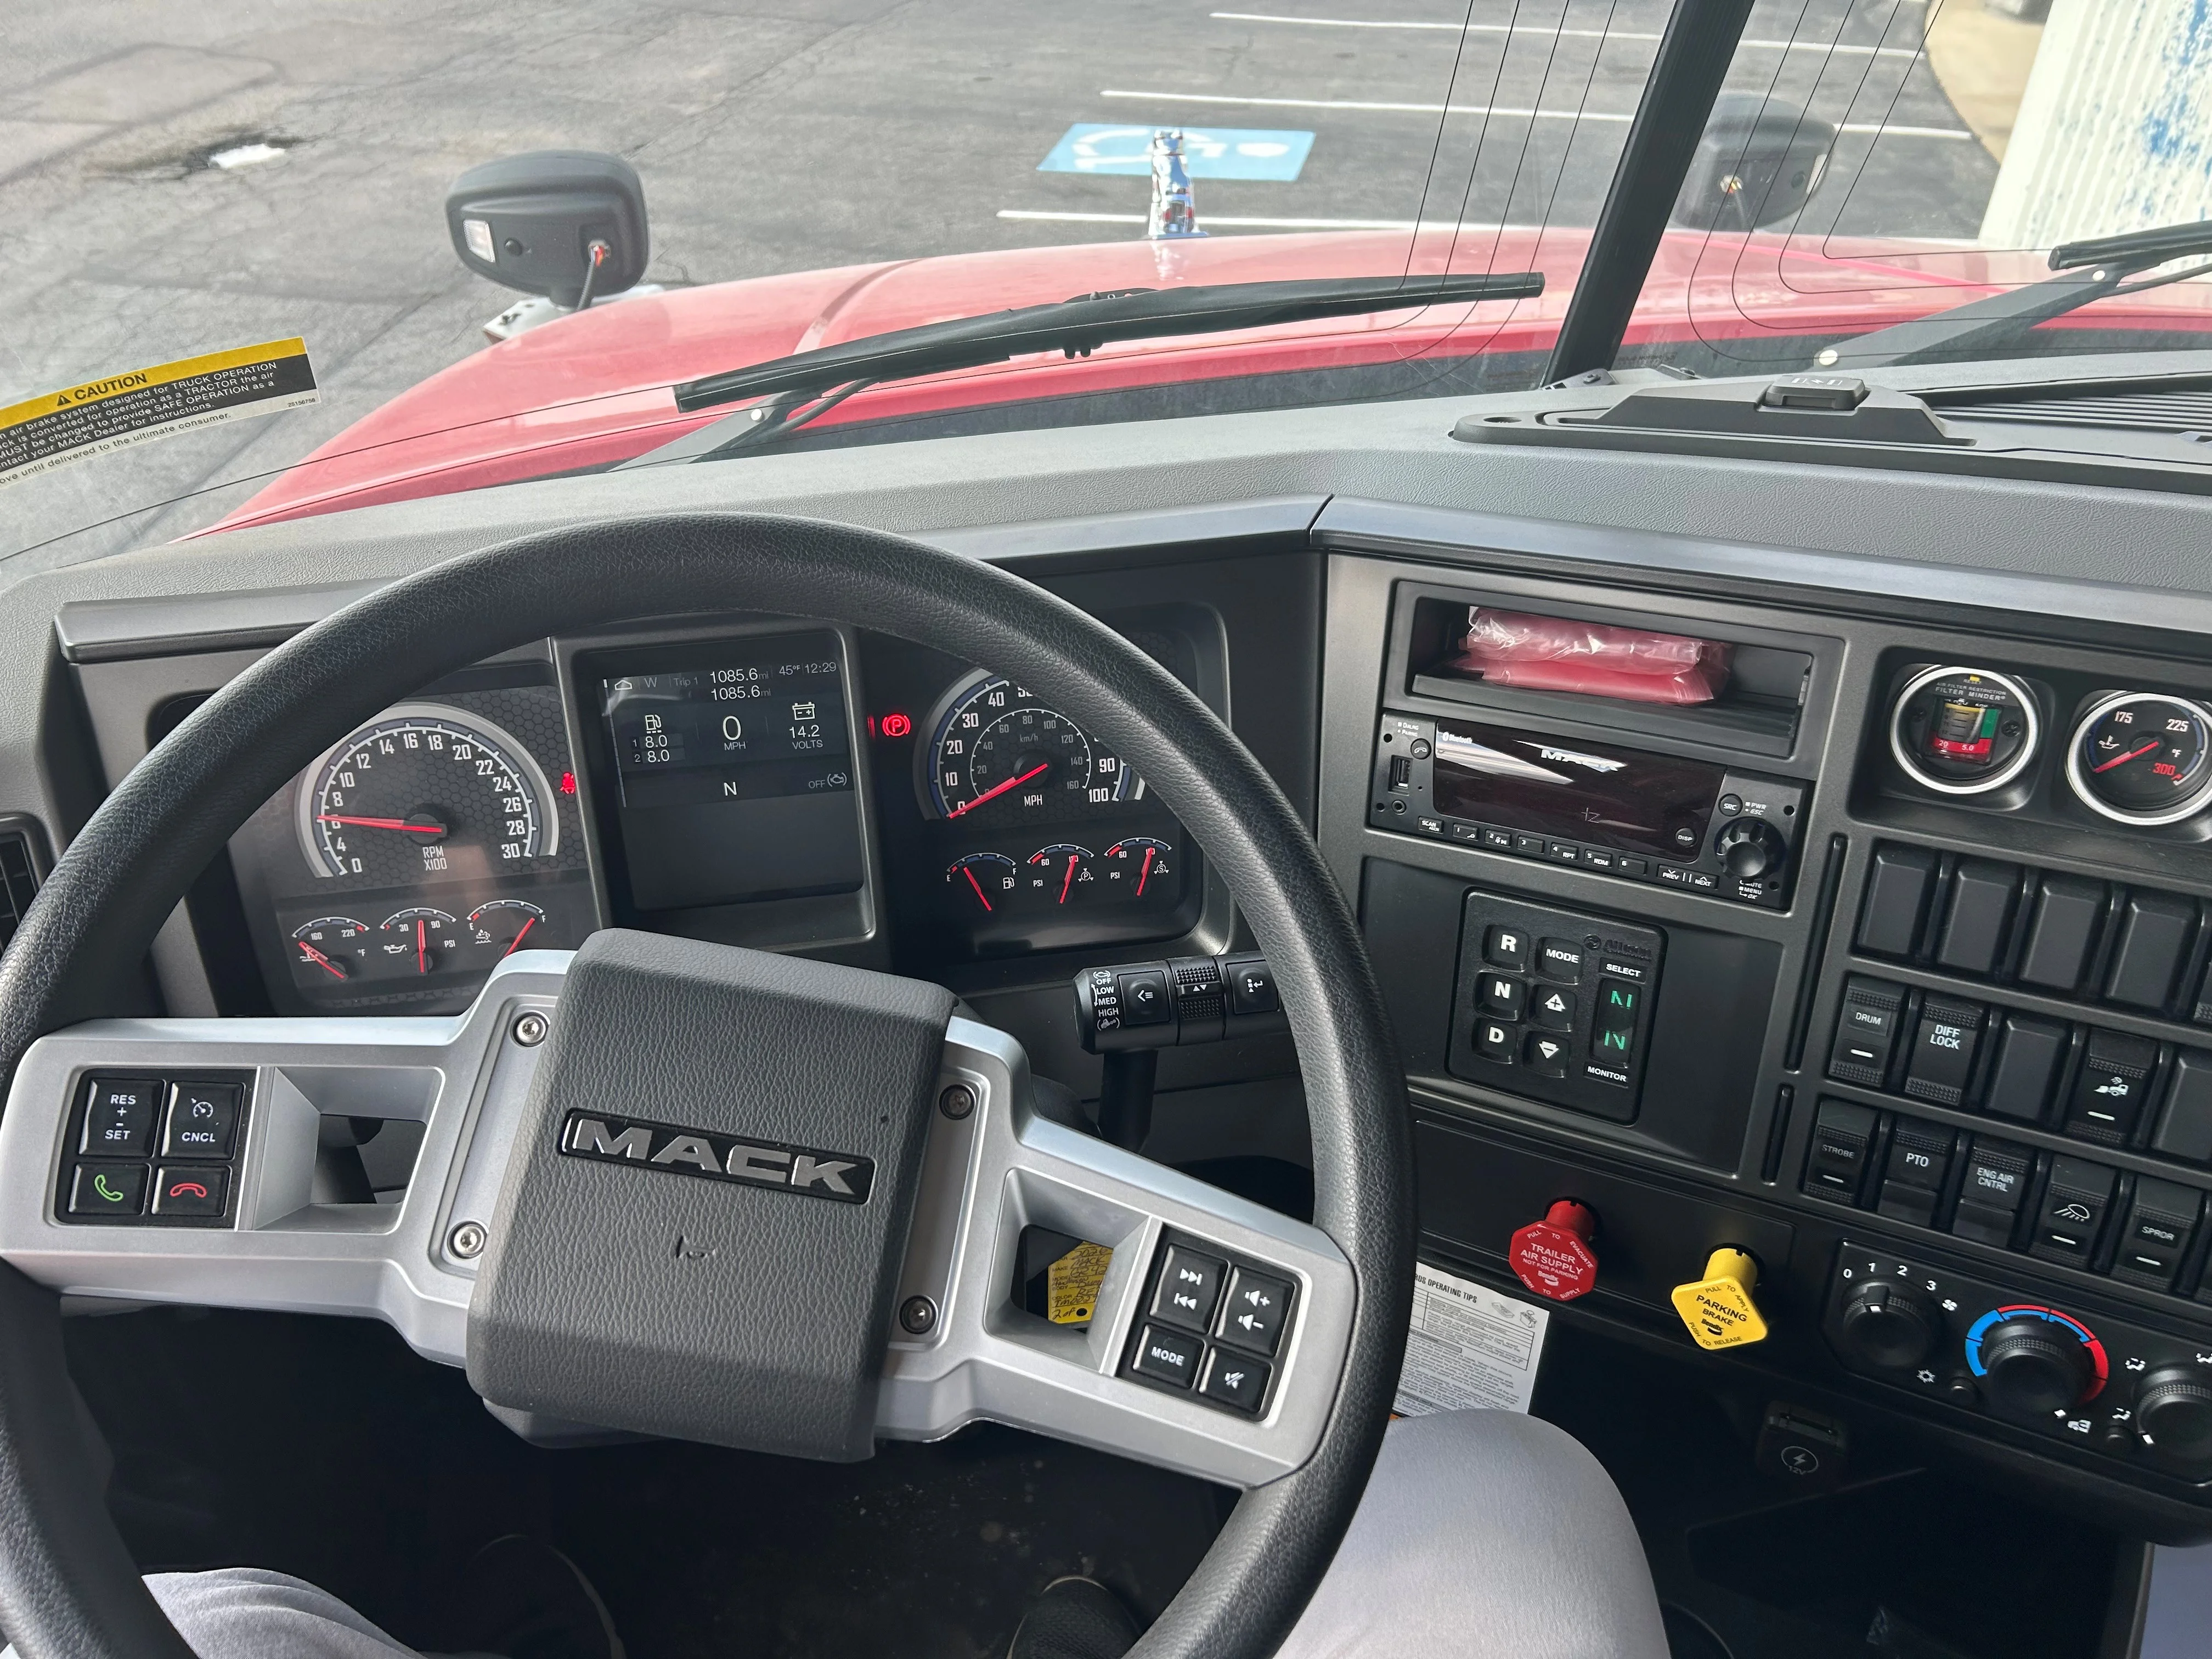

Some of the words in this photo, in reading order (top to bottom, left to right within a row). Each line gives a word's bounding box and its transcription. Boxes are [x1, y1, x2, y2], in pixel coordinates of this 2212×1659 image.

[74, 373, 147, 400] CAUTION
[9, 426, 23, 436] air
[26, 417, 57, 430] brake
[60, 404, 98, 420] system
[101, 390, 150, 408] designed
[154, 386, 168, 397] for
[171, 375, 210, 390] TRUCK
[213, 362, 277, 381] OPERATION
[30, 416, 84, 438] converted
[87, 411, 101, 422] for
[105, 398, 156, 419] operation
[160, 394, 172, 403] as
[184, 379, 238, 396] TRACTOR
[240, 374, 257, 384] the
[261, 371, 274, 380] air
[31, 439, 45, 447] be
[49, 421, 94, 442] changed
[111, 405, 151, 425] provide
[154, 400, 183, 412] SAFE
[186, 385, 249, 404] OPERATION
[31, 444, 55, 459] your
[57, 433, 92, 448] MACK
[94, 422, 128, 437] Dealer
[131, 417, 145, 427] for
[150, 403, 215, 422] instructions.
[21, 463, 44, 476] until
[48, 447, 96, 467] delivered
[112, 437, 130, 447] the
[133, 426, 175, 442] ultimate
[178, 413, 232, 430] consumer.
[804, 662, 837, 674] 12:29
[644, 678, 657, 688] W
[674, 678, 691, 687] Trip
[1936, 687, 1963, 696] FILTER
[988, 692, 1005, 707] 40
[962, 713, 979, 728] 30
[1023, 715, 1032, 724] 80
[2114, 711, 2132, 724] 175
[723, 715, 742, 740] 0
[789, 725, 820, 738] 14.2
[999, 724, 1009, 733] 60
[1043, 720, 1056, 730] 100
[2168, 719, 2188, 732] 225
[403, 733, 419, 749] 16
[428, 735, 443, 751] 18
[645, 735, 668, 748] 8.0
[792, 740, 823, 749] VOLTS
[1019, 733, 1039, 743] km/h
[1061, 735, 1073, 743] 120
[379, 739, 394, 754] 14
[453, 744, 471, 760] 20
[724, 741, 746, 751] MPH
[946, 740, 963, 755] 20
[983, 741, 993, 751] 40
[357, 754, 371, 769] 12
[647, 749, 670, 763] 8.0
[1070, 757, 1082, 765] 140
[476, 759, 494, 775] 22
[977, 765, 986, 774] 20
[1099, 758, 1115, 772] 90
[2153, 761, 2175, 776] 300
[340, 772, 354, 788] 10
[493, 777, 512, 792] 24
[809, 780, 825, 789] OFF
[946, 772, 958, 786] 10
[1066, 781, 1079, 789] 160
[724, 781, 737, 796] N
[1088, 788, 1109, 803] 100
[333, 791, 343, 806] 8
[504, 797, 522, 812] 26
[1024, 795, 1042, 806] MPH
[507, 819, 525, 835] 28
[337, 837, 346, 851] 4
[501, 843, 520, 859] 30
[422, 846, 444, 857] RPM
[352, 858, 362, 873] 0
[425, 857, 447, 870] X100
[1662, 872, 1678, 881] PREV
[431, 920, 441, 928] 90
[341, 929, 355, 938] 220
[1501, 934, 1516, 952] R
[1546, 949, 1579, 963] MODE
[1606, 963, 1640, 977] SELECT
[1097, 986, 1114, 995] LOW
[1494, 981, 1510, 998] N
[1098, 997, 1116, 1006] MED
[1098, 1008, 1119, 1017] HIGH
[1856, 1012, 1881, 1025] DRUM
[1488, 1026, 1504, 1043] D
[1935, 1024, 1960, 1038] DIFF
[1930, 1034, 1960, 1050] LOCK
[1587, 1066, 1627, 1082] MONITOR
[110, 1094, 136, 1104] RES
[105, 1130, 131, 1140] SET
[182, 1132, 216, 1142] CNCL
[572, 1118, 858, 1195] MACK
[1821, 1144, 1854, 1159] STROBE
[1906, 1153, 1929, 1167] PTO
[1977, 1167, 1997, 1180] ENG
[1997, 1172, 2014, 1184] AIR
[1977, 1176, 2008, 1192] CNTRL
[1527, 1230, 1542, 1239] PULL
[1570, 1241, 1594, 1268] EVACUATE
[1531, 1243, 1575, 1264] TRAILER
[1521, 1250, 1538, 1261] AIR
[1541, 1256, 1583, 1274] SUPPLY
[1868, 1262, 1876, 1272] 1
[1550, 1268, 1578, 1280] PARKING
[1843, 1268, 1852, 1278] 0
[1897, 1266, 1908, 1276] 2
[1428, 1279, 1461, 1297] OPERATING
[1463, 1292, 1477, 1303] TIPS
[1522, 1274, 1534, 1288] PUSH
[1560, 1288, 1580, 1299] SUPPLY
[1926, 1280, 1937, 1291] 3
[1696, 1295, 1747, 1322] PARKING
[1735, 1295, 1749, 1312] APPLY
[1703, 1308, 1734, 1326] BRAKE
[1714, 1336, 1742, 1345] RELEASE
[1152, 1346, 1186, 1367] MODE
